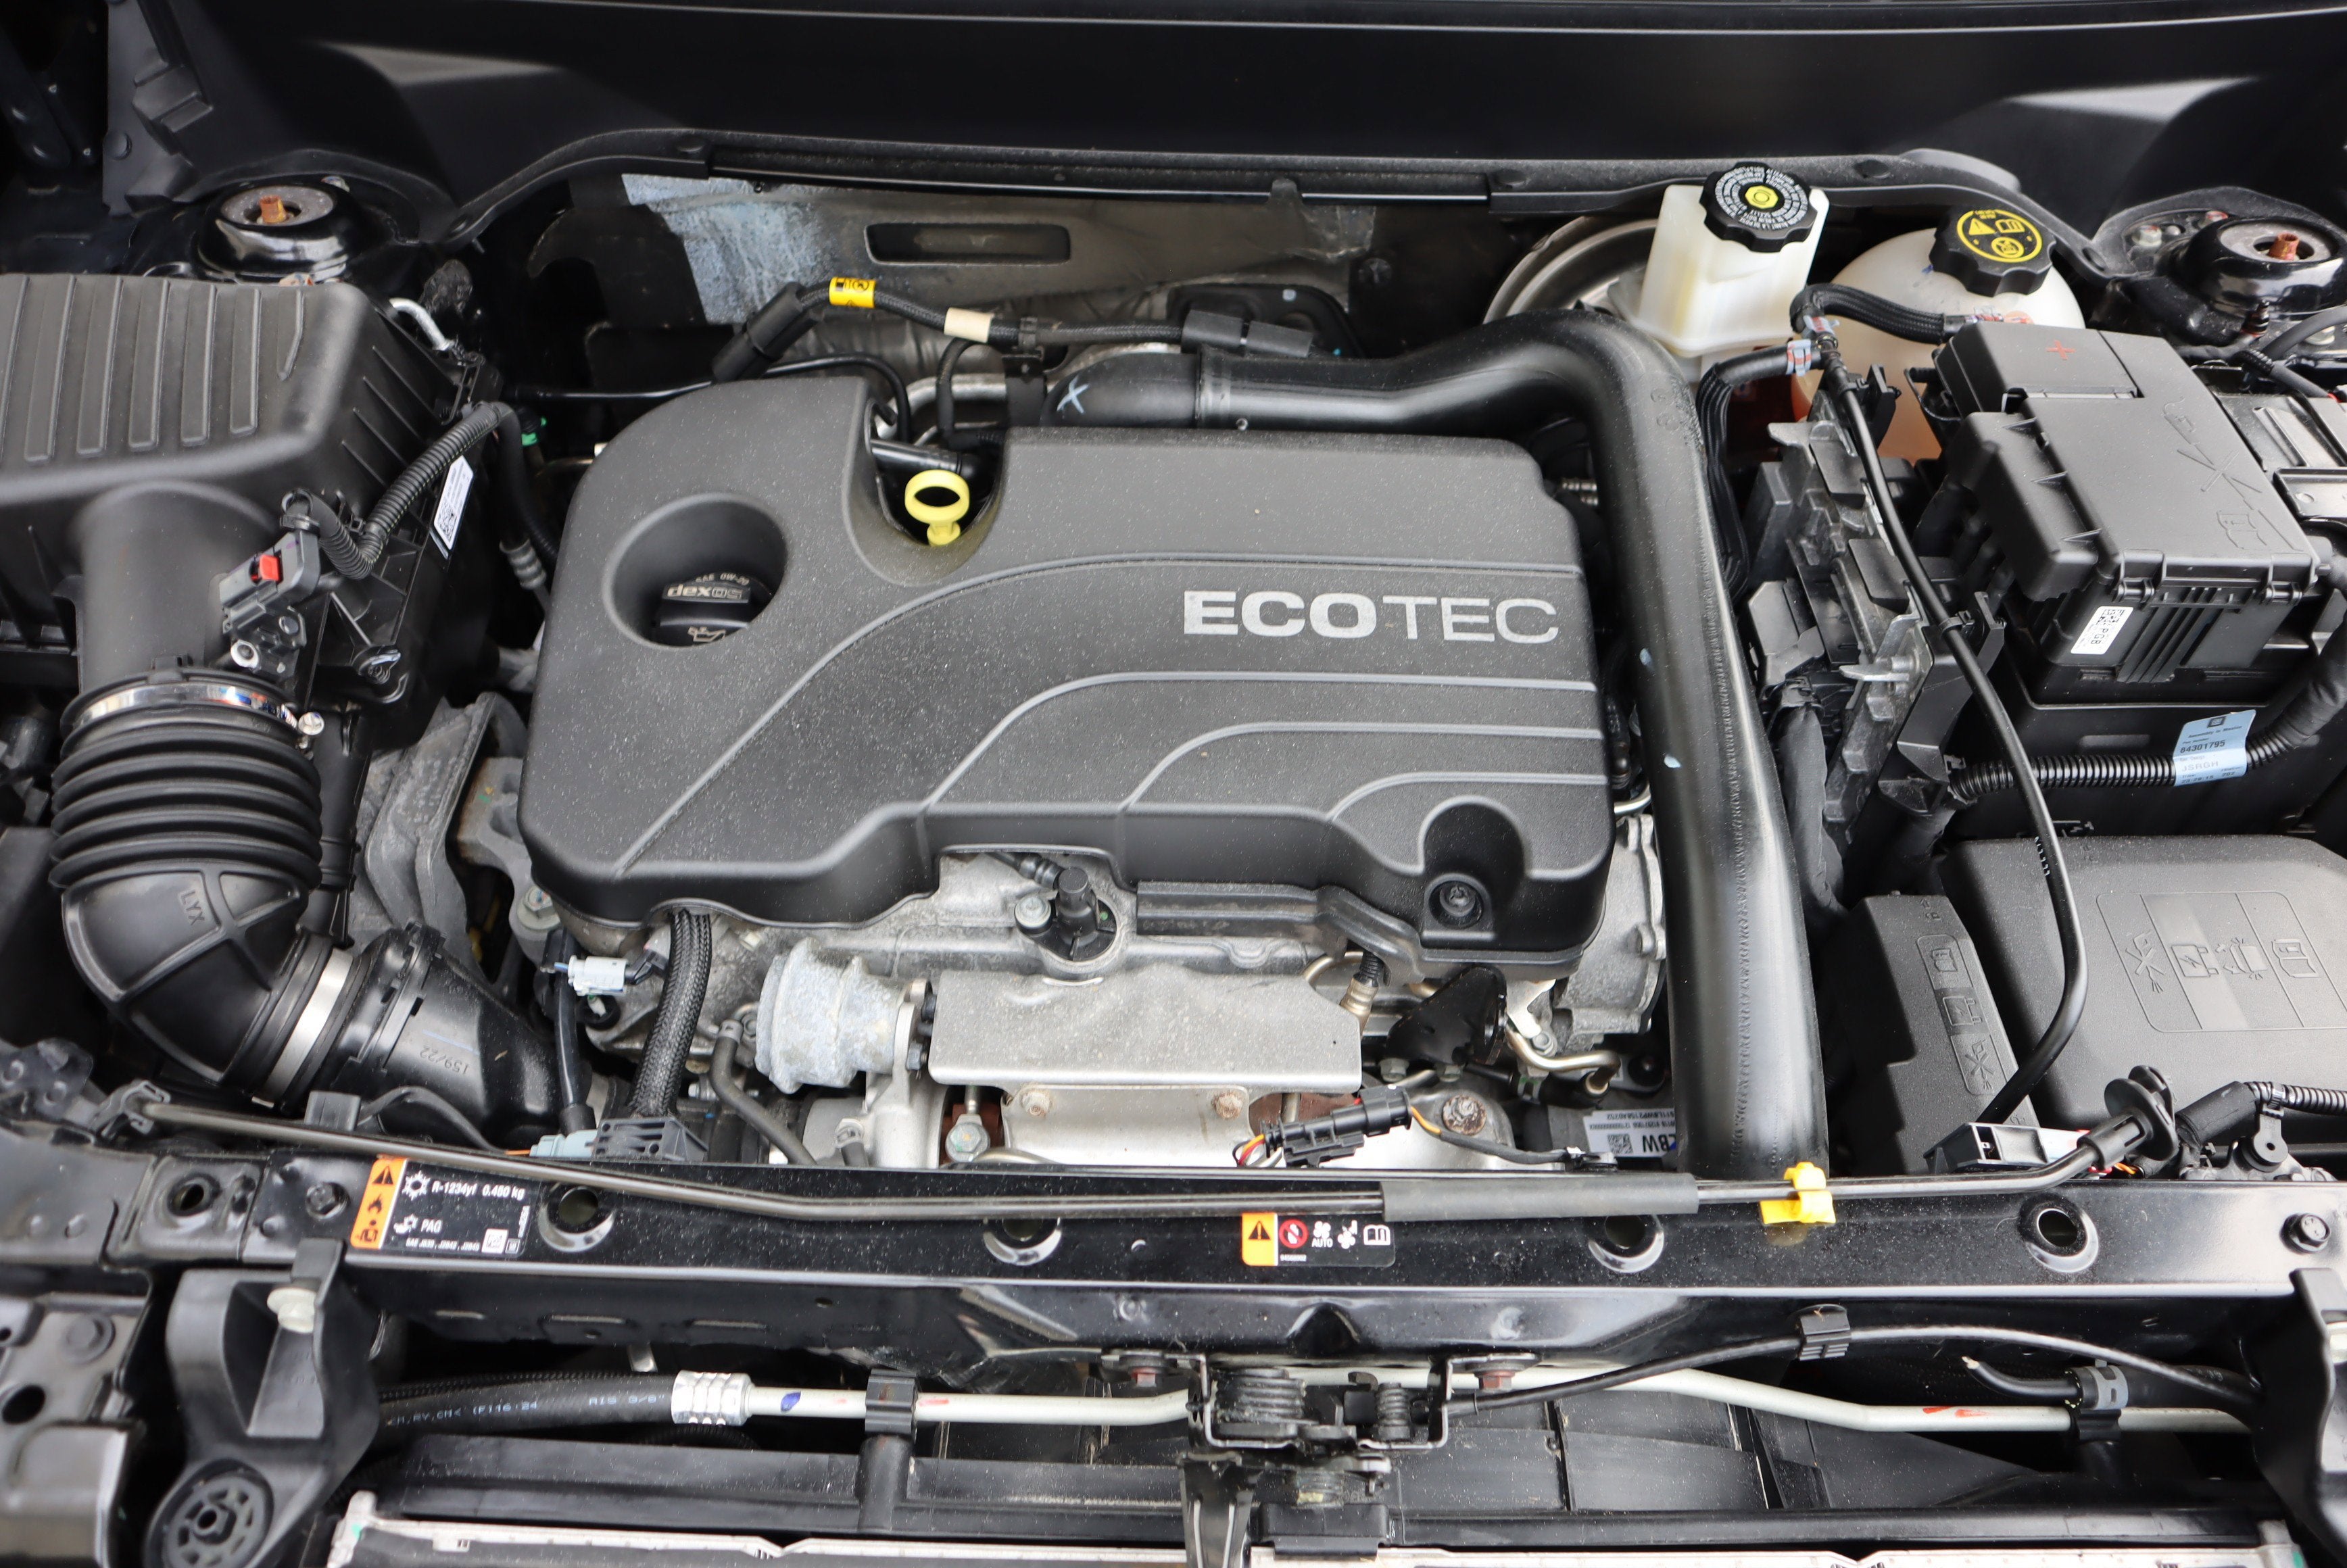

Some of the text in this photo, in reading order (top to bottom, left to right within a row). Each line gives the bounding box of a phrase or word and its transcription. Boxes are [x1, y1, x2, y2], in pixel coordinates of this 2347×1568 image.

[720, 572, 750, 586] 0W-20
[667, 583, 744, 600] dexos
[1184, 590, 1559, 643] ECOTEC
[2179, 739, 2225, 754] 84301795
[180, 890, 205, 926] LYX
[419, 1046, 470, 1075] 159/22
[510, 1185, 526, 1201] kg
[1311, 1238, 1333, 1248] AUTO
